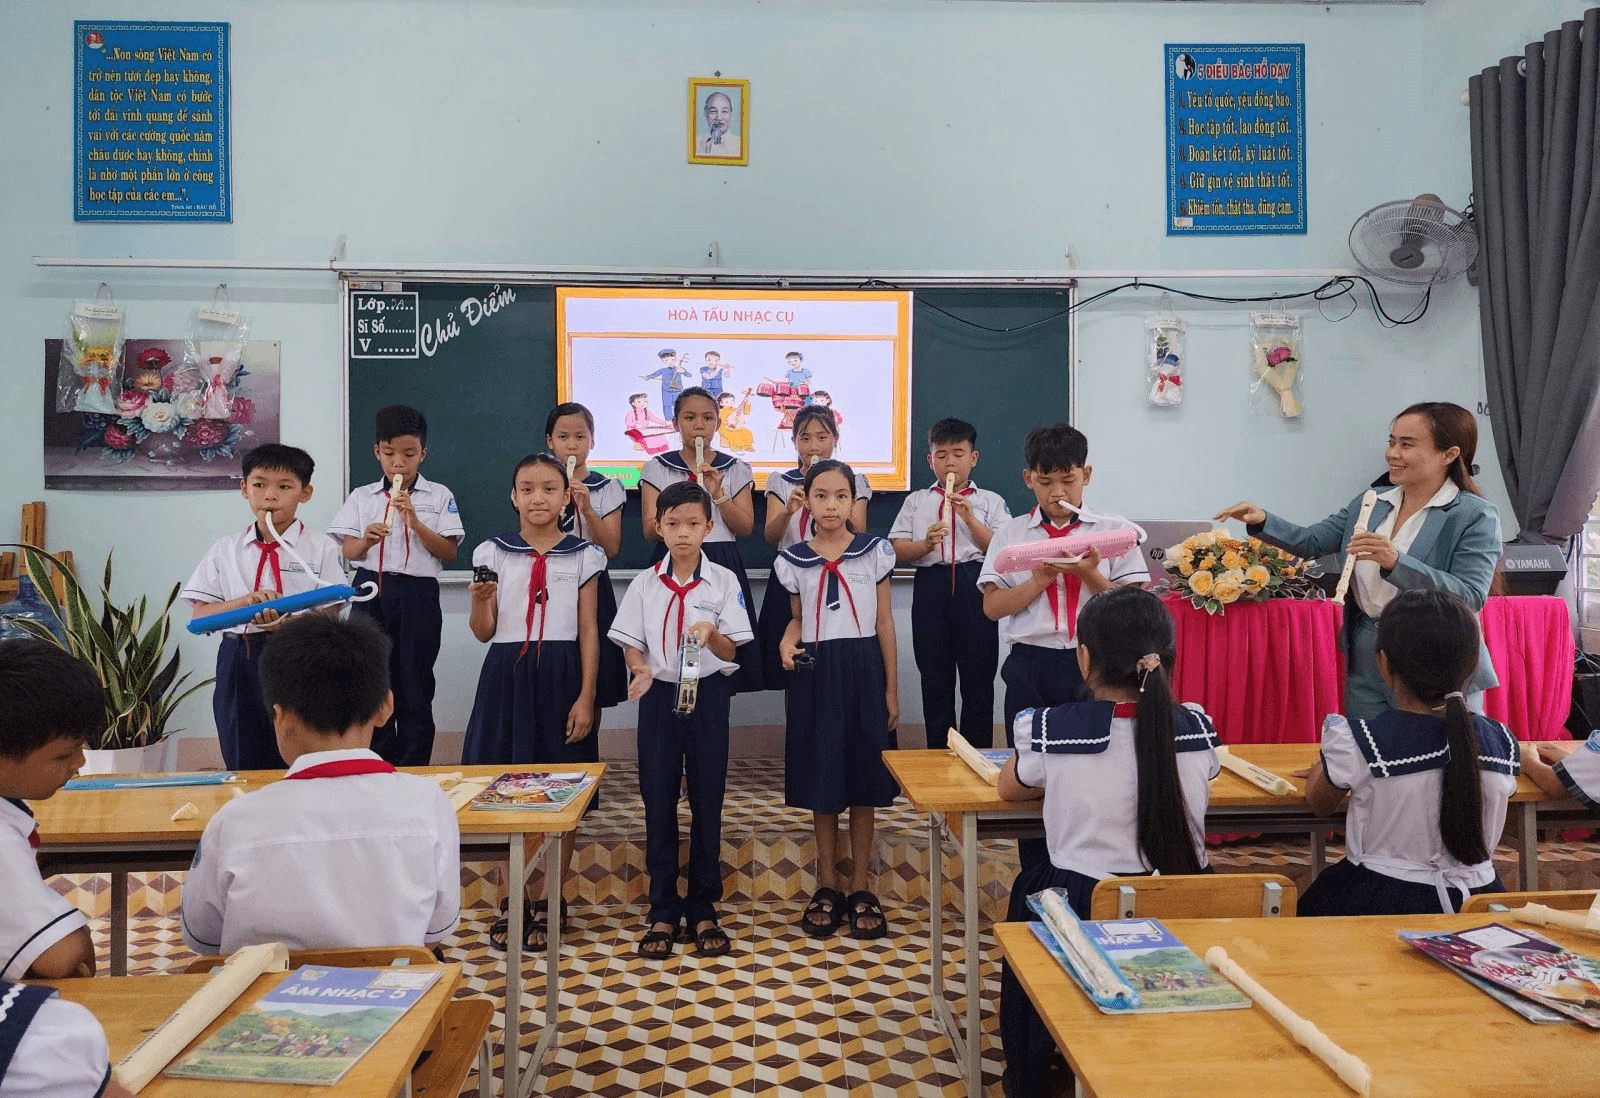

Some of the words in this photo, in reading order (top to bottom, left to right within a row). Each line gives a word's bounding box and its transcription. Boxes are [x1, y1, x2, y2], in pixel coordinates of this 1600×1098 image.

[134, 48, 155, 63] sông
[158, 48, 176, 62] Việt
[179, 48, 199, 61] Nam
[202, 48, 213, 61] có
[144, 69, 161, 85] đẹp
[1198, 64, 1204, 80] 5
[1206, 57, 1229, 80] ĐIỀU
[1270, 63, 1290, 83] DẠY
[88, 88, 106, 102] dân
[128, 88, 147, 103] Việt
[151, 88, 172, 102] Nam
[176, 90, 187, 102] có
[191, 88, 213, 103] bước
[1237, 91, 1252, 112] yêu
[122, 109, 142, 121] vinh
[145, 111, 174, 125] quang
[191, 109, 213, 122] sánh
[1188, 118, 1205, 138] Học
[1239, 117, 1252, 134] lao
[88, 128, 102, 141] vai
[121, 129, 137, 141] các
[139, 129, 166, 144] cường
[169, 128, 191, 144] quốc
[88, 147, 110, 161] châu
[112, 147, 134, 163] được
[136, 147, 152, 164] hay
[155, 147, 186, 165] không,
[187, 148, 213, 162] chính
[120, 169, 138, 183] một
[192, 169, 214, 184] công
[1236, 171, 1255, 188] sinh
[88, 187, 106, 203] học
[143, 188, 159, 201] các
[421, 312, 460, 357] Chủ
[460, 284, 517, 326] Điểm
[668, 307, 698, 322] HOÀ
[702, 305, 729, 322] TẤU
[733, 309, 772, 325] NHẠC
[775, 310, 795, 325] CỤ
[1514, 559, 1551, 569] YAMAHA
[1094, 934, 1143, 945] HẠC
[280, 983, 320, 997] ÂM
[320, 987, 385, 1000] NHẠC
[389, 988, 408, 999] 5
